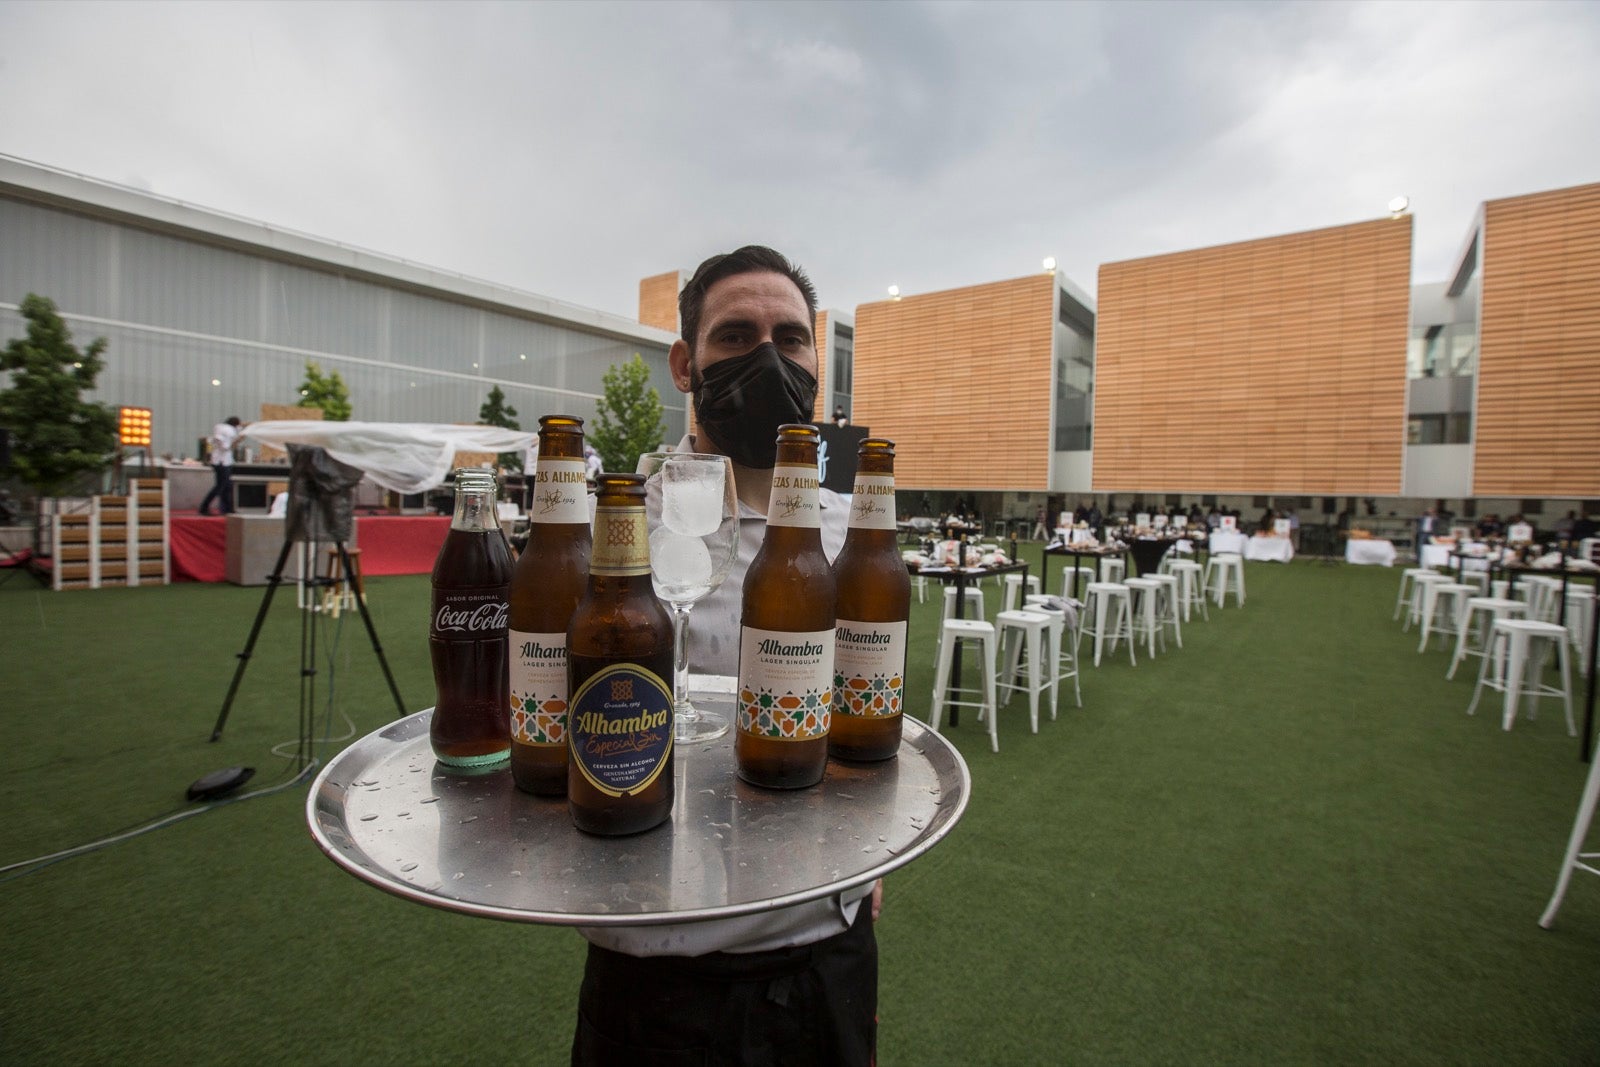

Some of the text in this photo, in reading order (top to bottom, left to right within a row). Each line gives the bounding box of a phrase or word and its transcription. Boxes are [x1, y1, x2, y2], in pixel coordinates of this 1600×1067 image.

[435, 601, 510, 632] Coca-Cola
[835, 627, 891, 644] Alhambra
[519, 641, 568, 659] Alham
[757, 639, 824, 657] Alhambra
[576, 709, 668, 735] Alhambra
[631, 757, 656, 767] ALCOHOL
[610, 774, 637, 782] NATURAL
